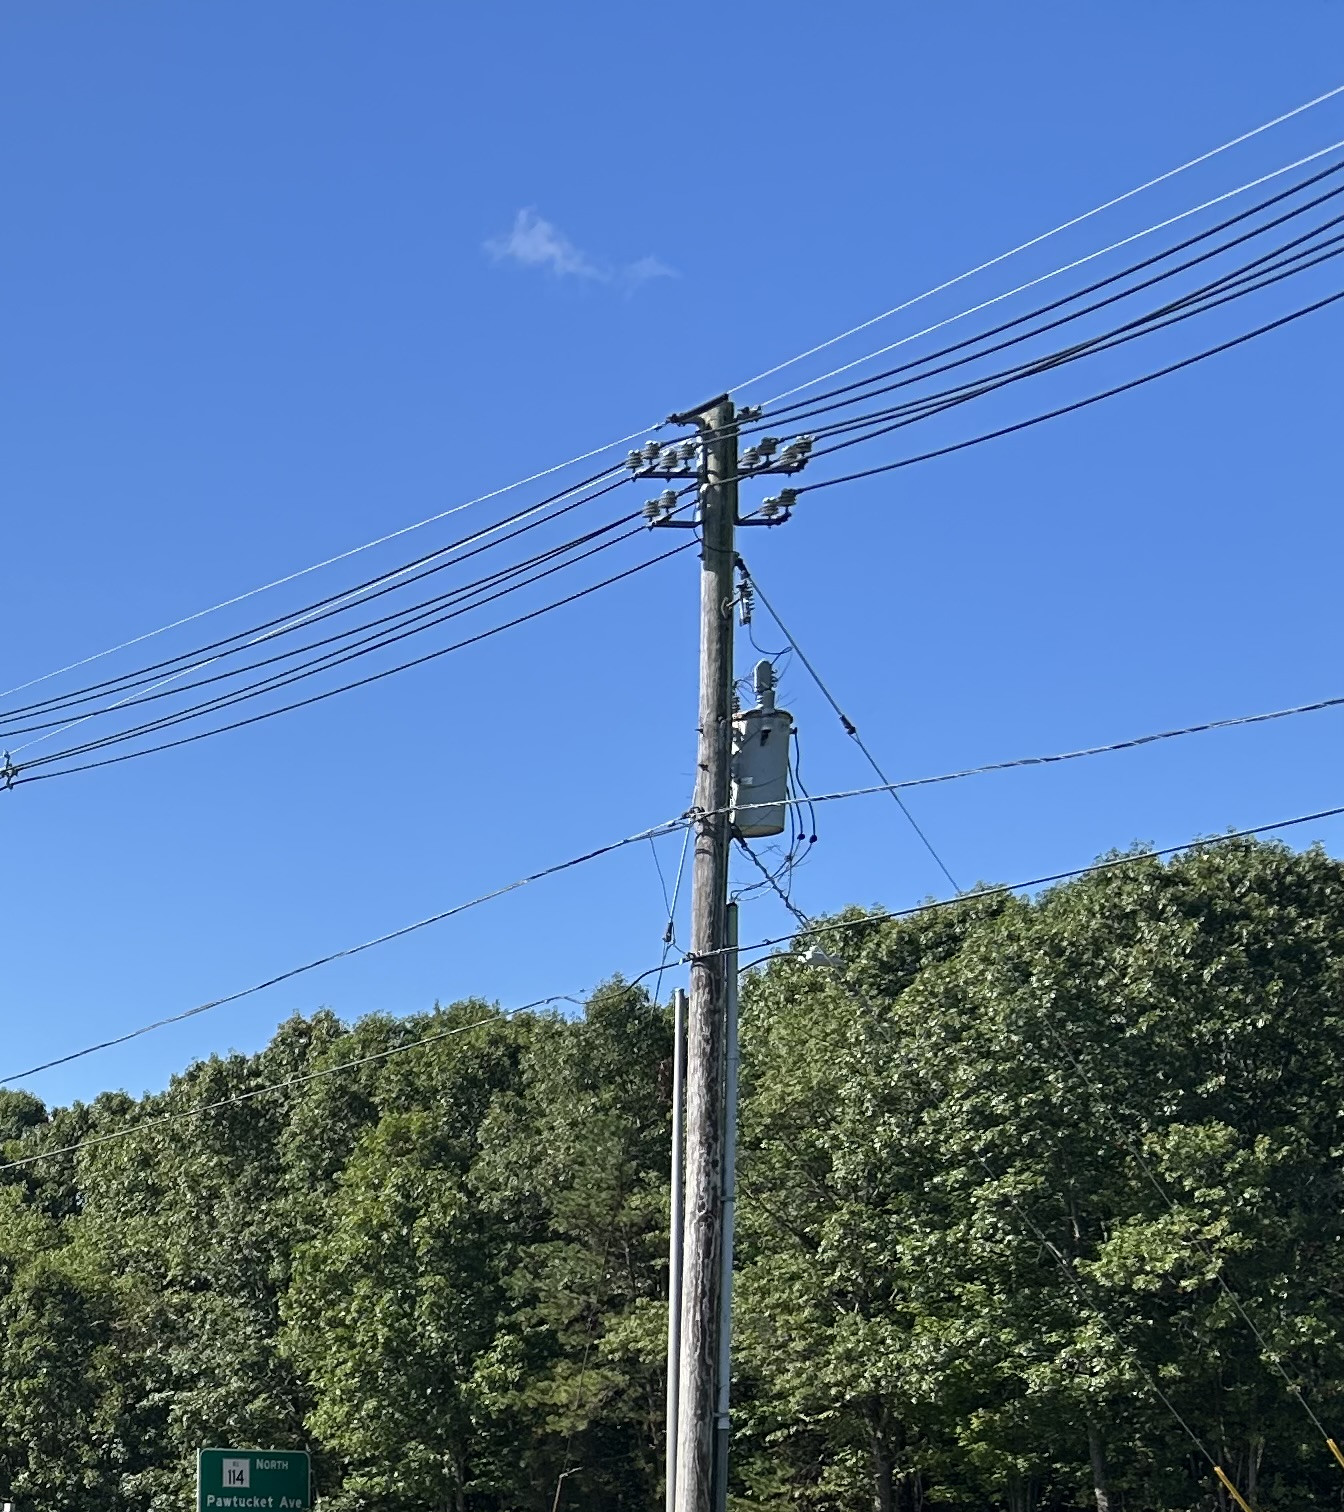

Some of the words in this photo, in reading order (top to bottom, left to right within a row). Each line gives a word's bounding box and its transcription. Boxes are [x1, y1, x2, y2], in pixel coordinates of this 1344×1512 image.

[256, 1459, 289, 1470] NORTH
[227, 1470, 244, 1485] 114
[206, 1494, 273, 1508] Pawtucket
[279, 1496, 302, 1508] Ave
